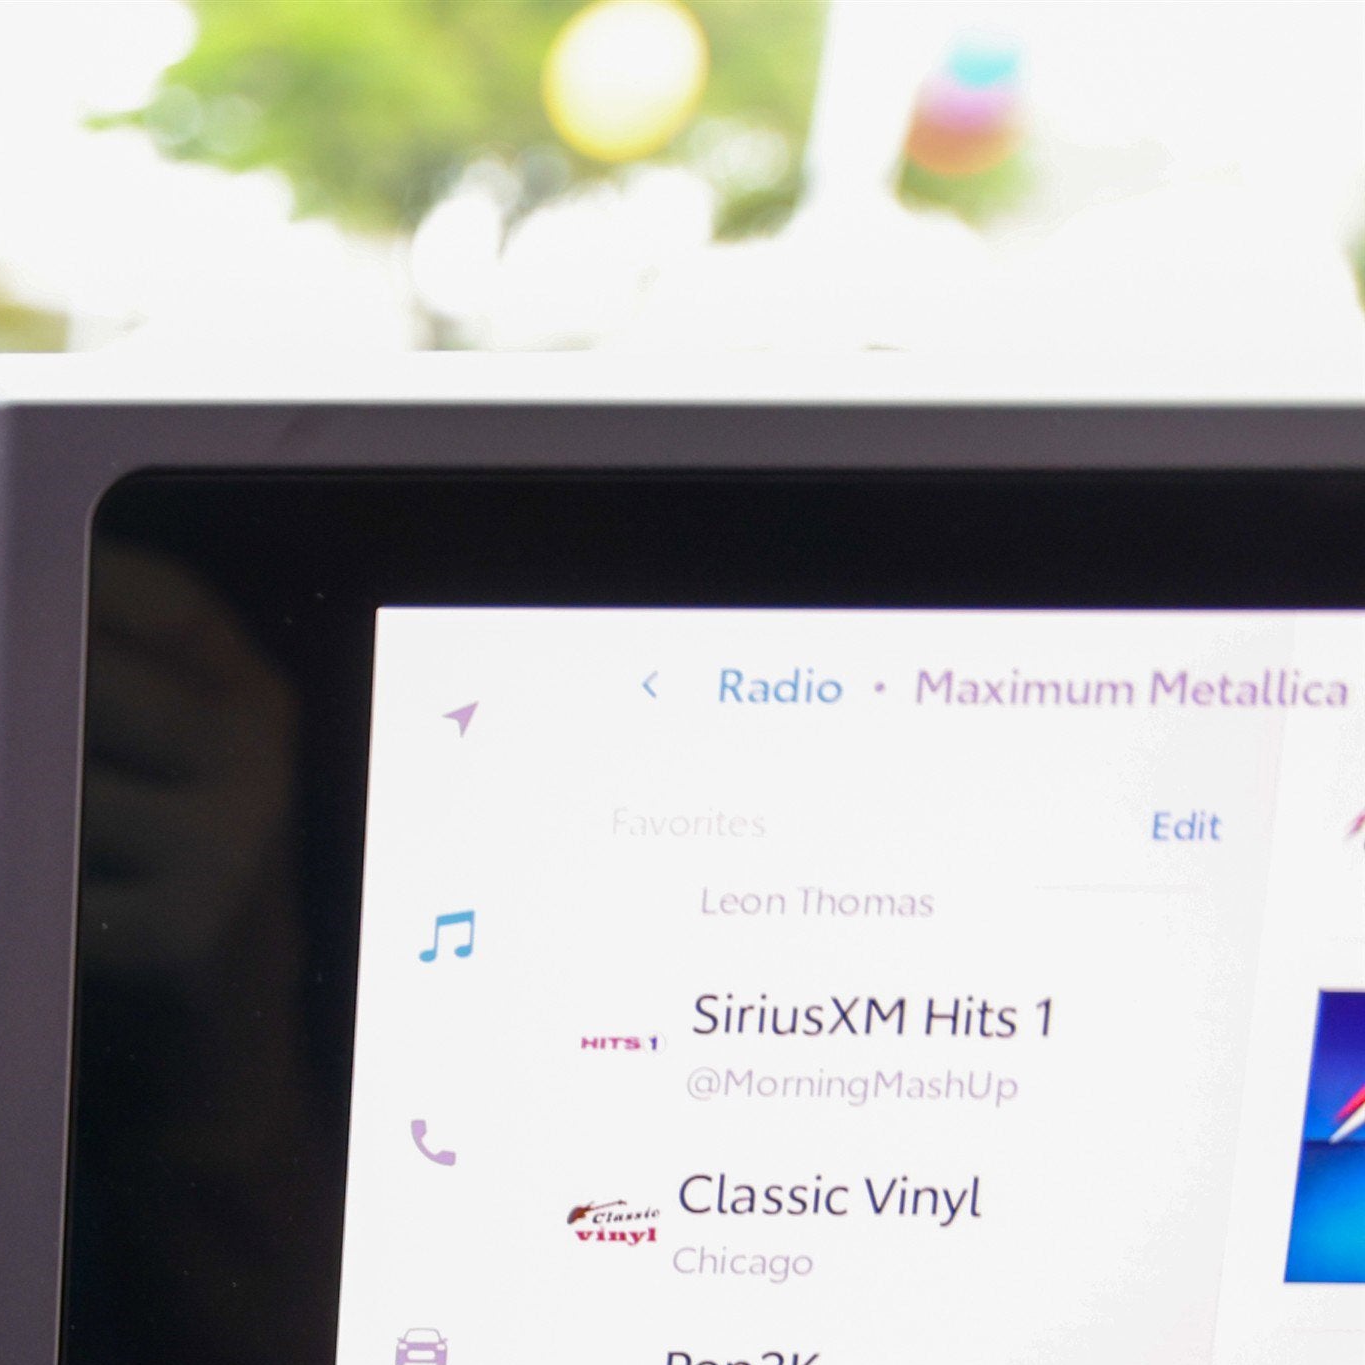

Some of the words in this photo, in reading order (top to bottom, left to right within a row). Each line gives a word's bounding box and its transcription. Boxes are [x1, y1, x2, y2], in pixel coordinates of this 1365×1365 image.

[718, 668, 843, 707] Radio
[915, 668, 1134, 709] Maximum
[1149, 670, 1350, 711] Metallica
[611, 807, 766, 840] Favorites
[1151, 812, 1222, 842] Edit
[701, 887, 785, 916] Leon
[798, 887, 934, 918] Thomas
[693, 994, 906, 1036] SiriusXM
[925, 997, 1017, 1038] Hits
[1036, 997, 1054, 1038] 1
[581, 1036, 641, 1050] HITS
[686, 1067, 1019, 1107] @MorningMashUp
[678, 1174, 849, 1217] Classic
[863, 1176, 983, 1226] Vinyl
[575, 1227, 657, 1246] vinyl
[672, 1246, 813, 1282] Chicago
